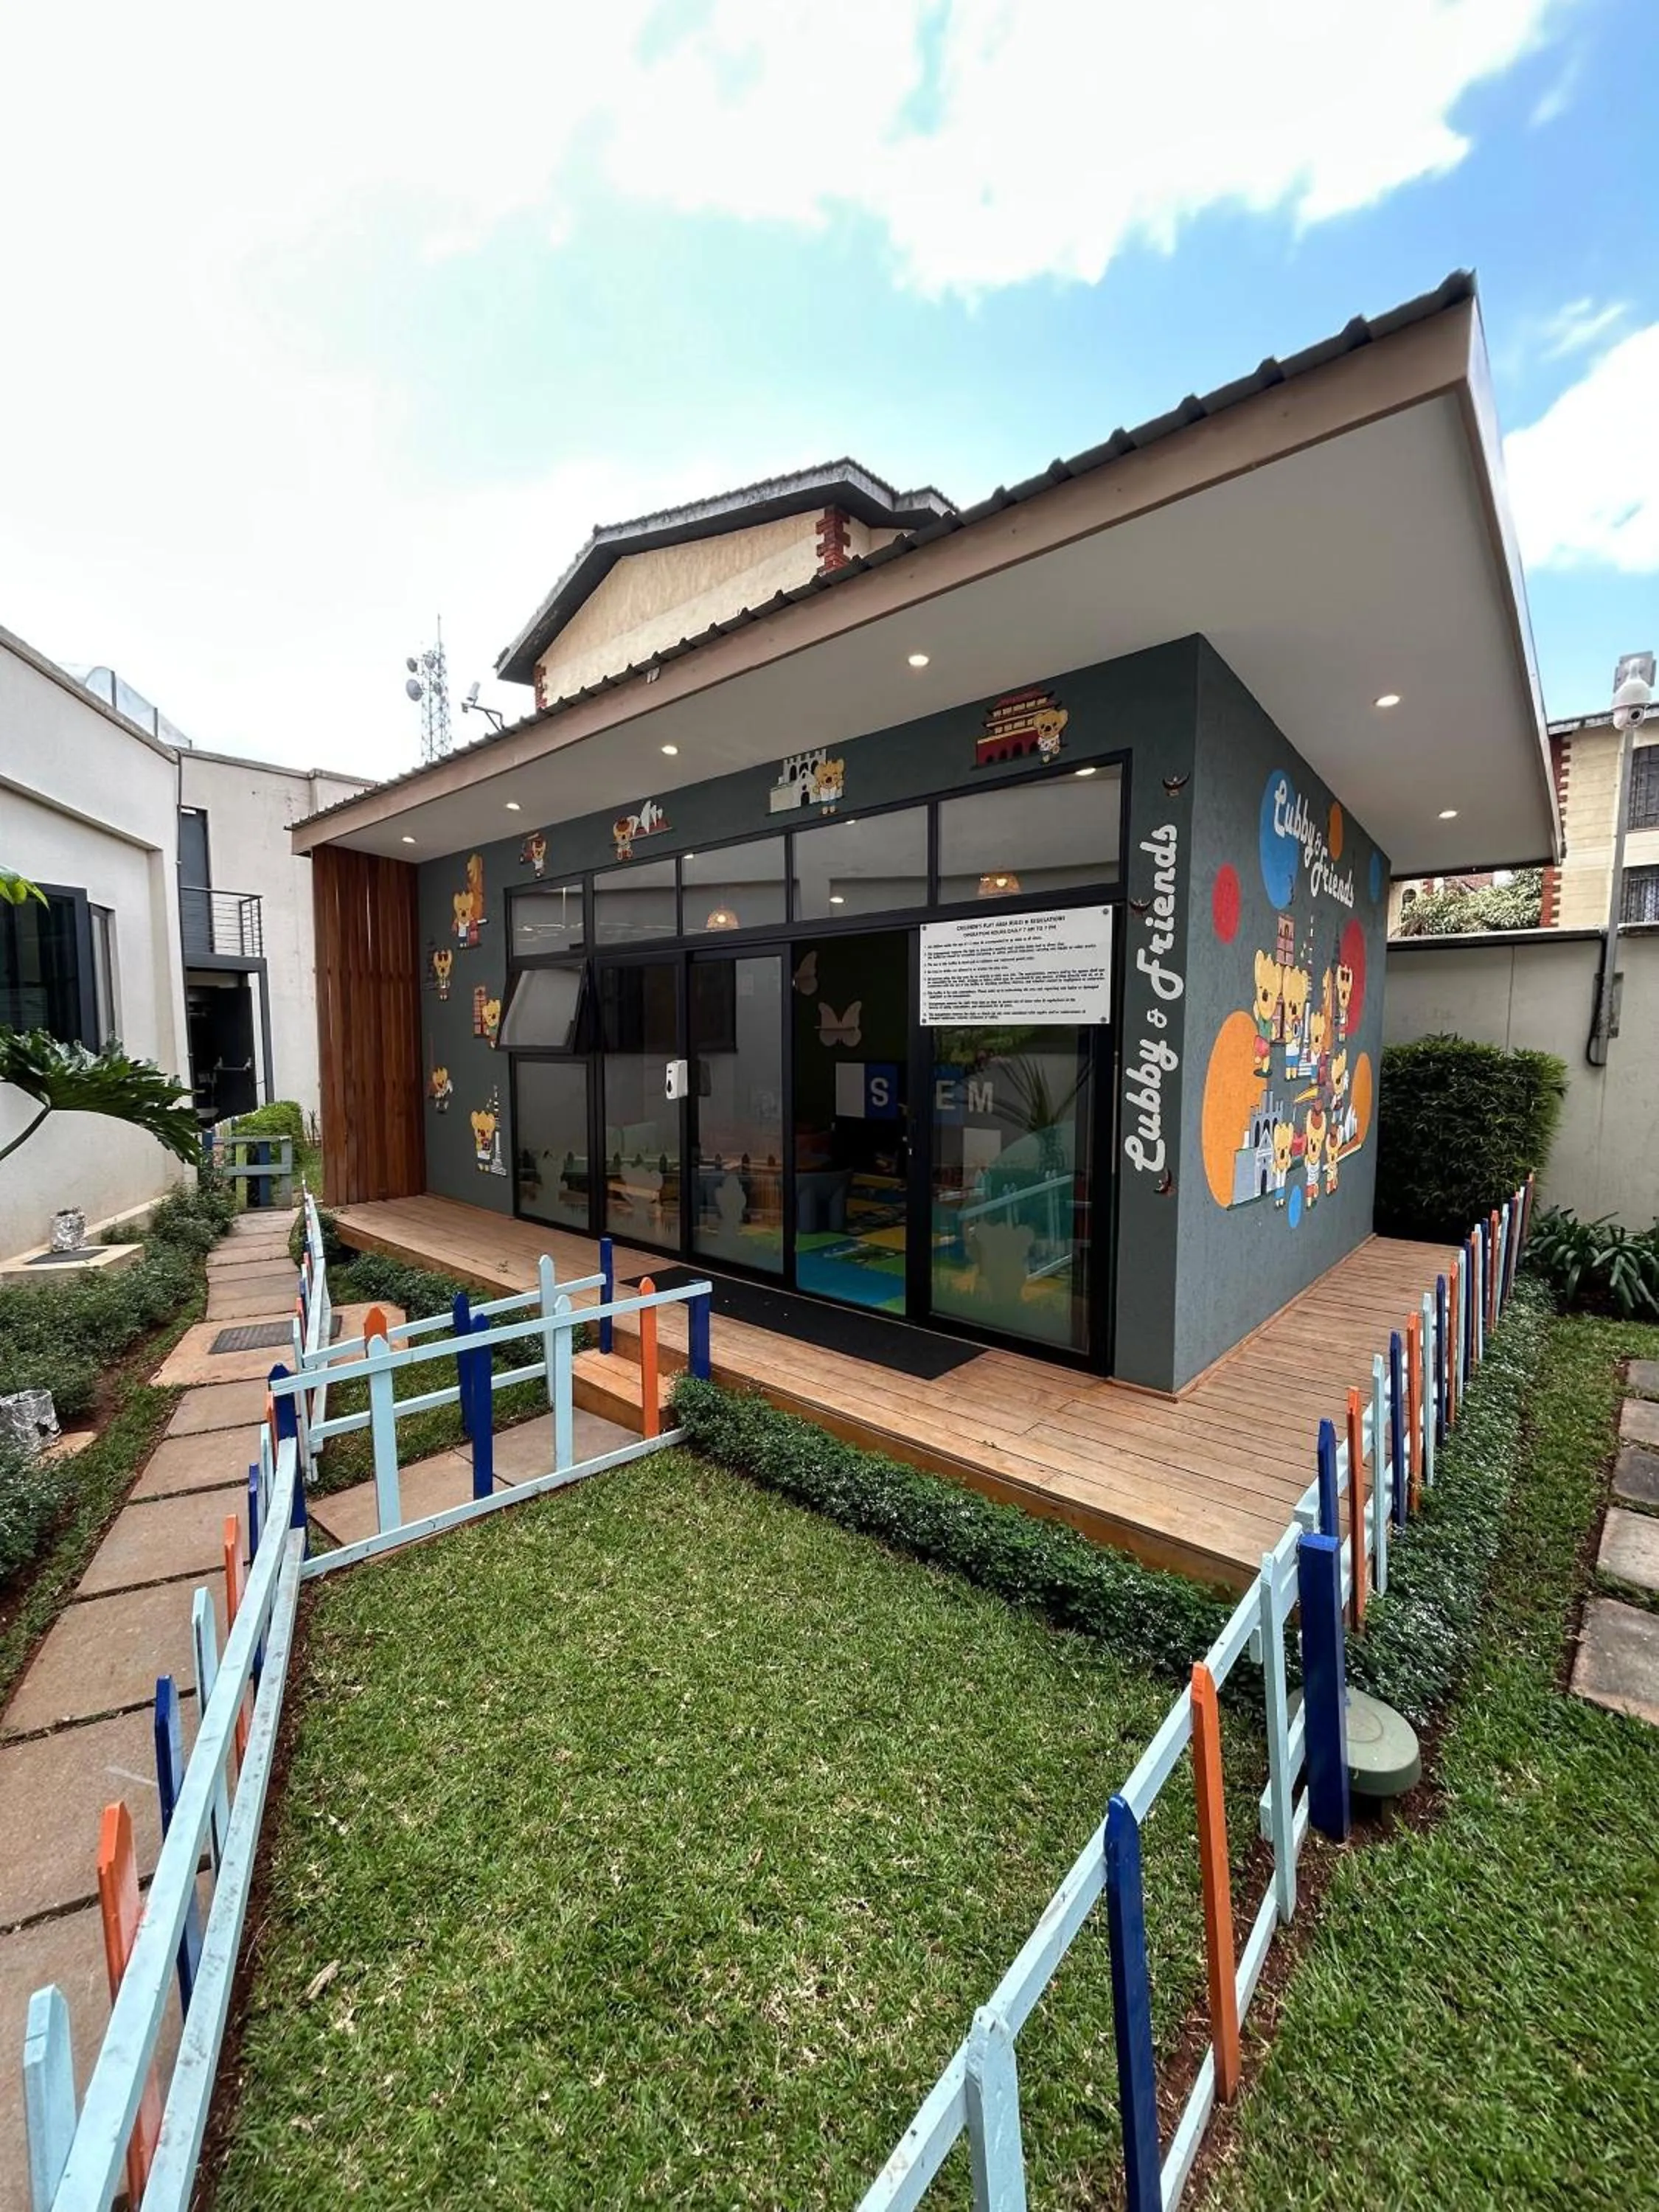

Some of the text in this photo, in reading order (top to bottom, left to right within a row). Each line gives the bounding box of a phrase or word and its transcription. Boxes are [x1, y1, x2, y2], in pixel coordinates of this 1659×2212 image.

[1274, 779, 1316, 868] Cubby
[1310, 846, 1354, 908] Friends
[1136, 824, 1184, 1001] Friends
[1124, 1039, 1179, 1172] Cubby
